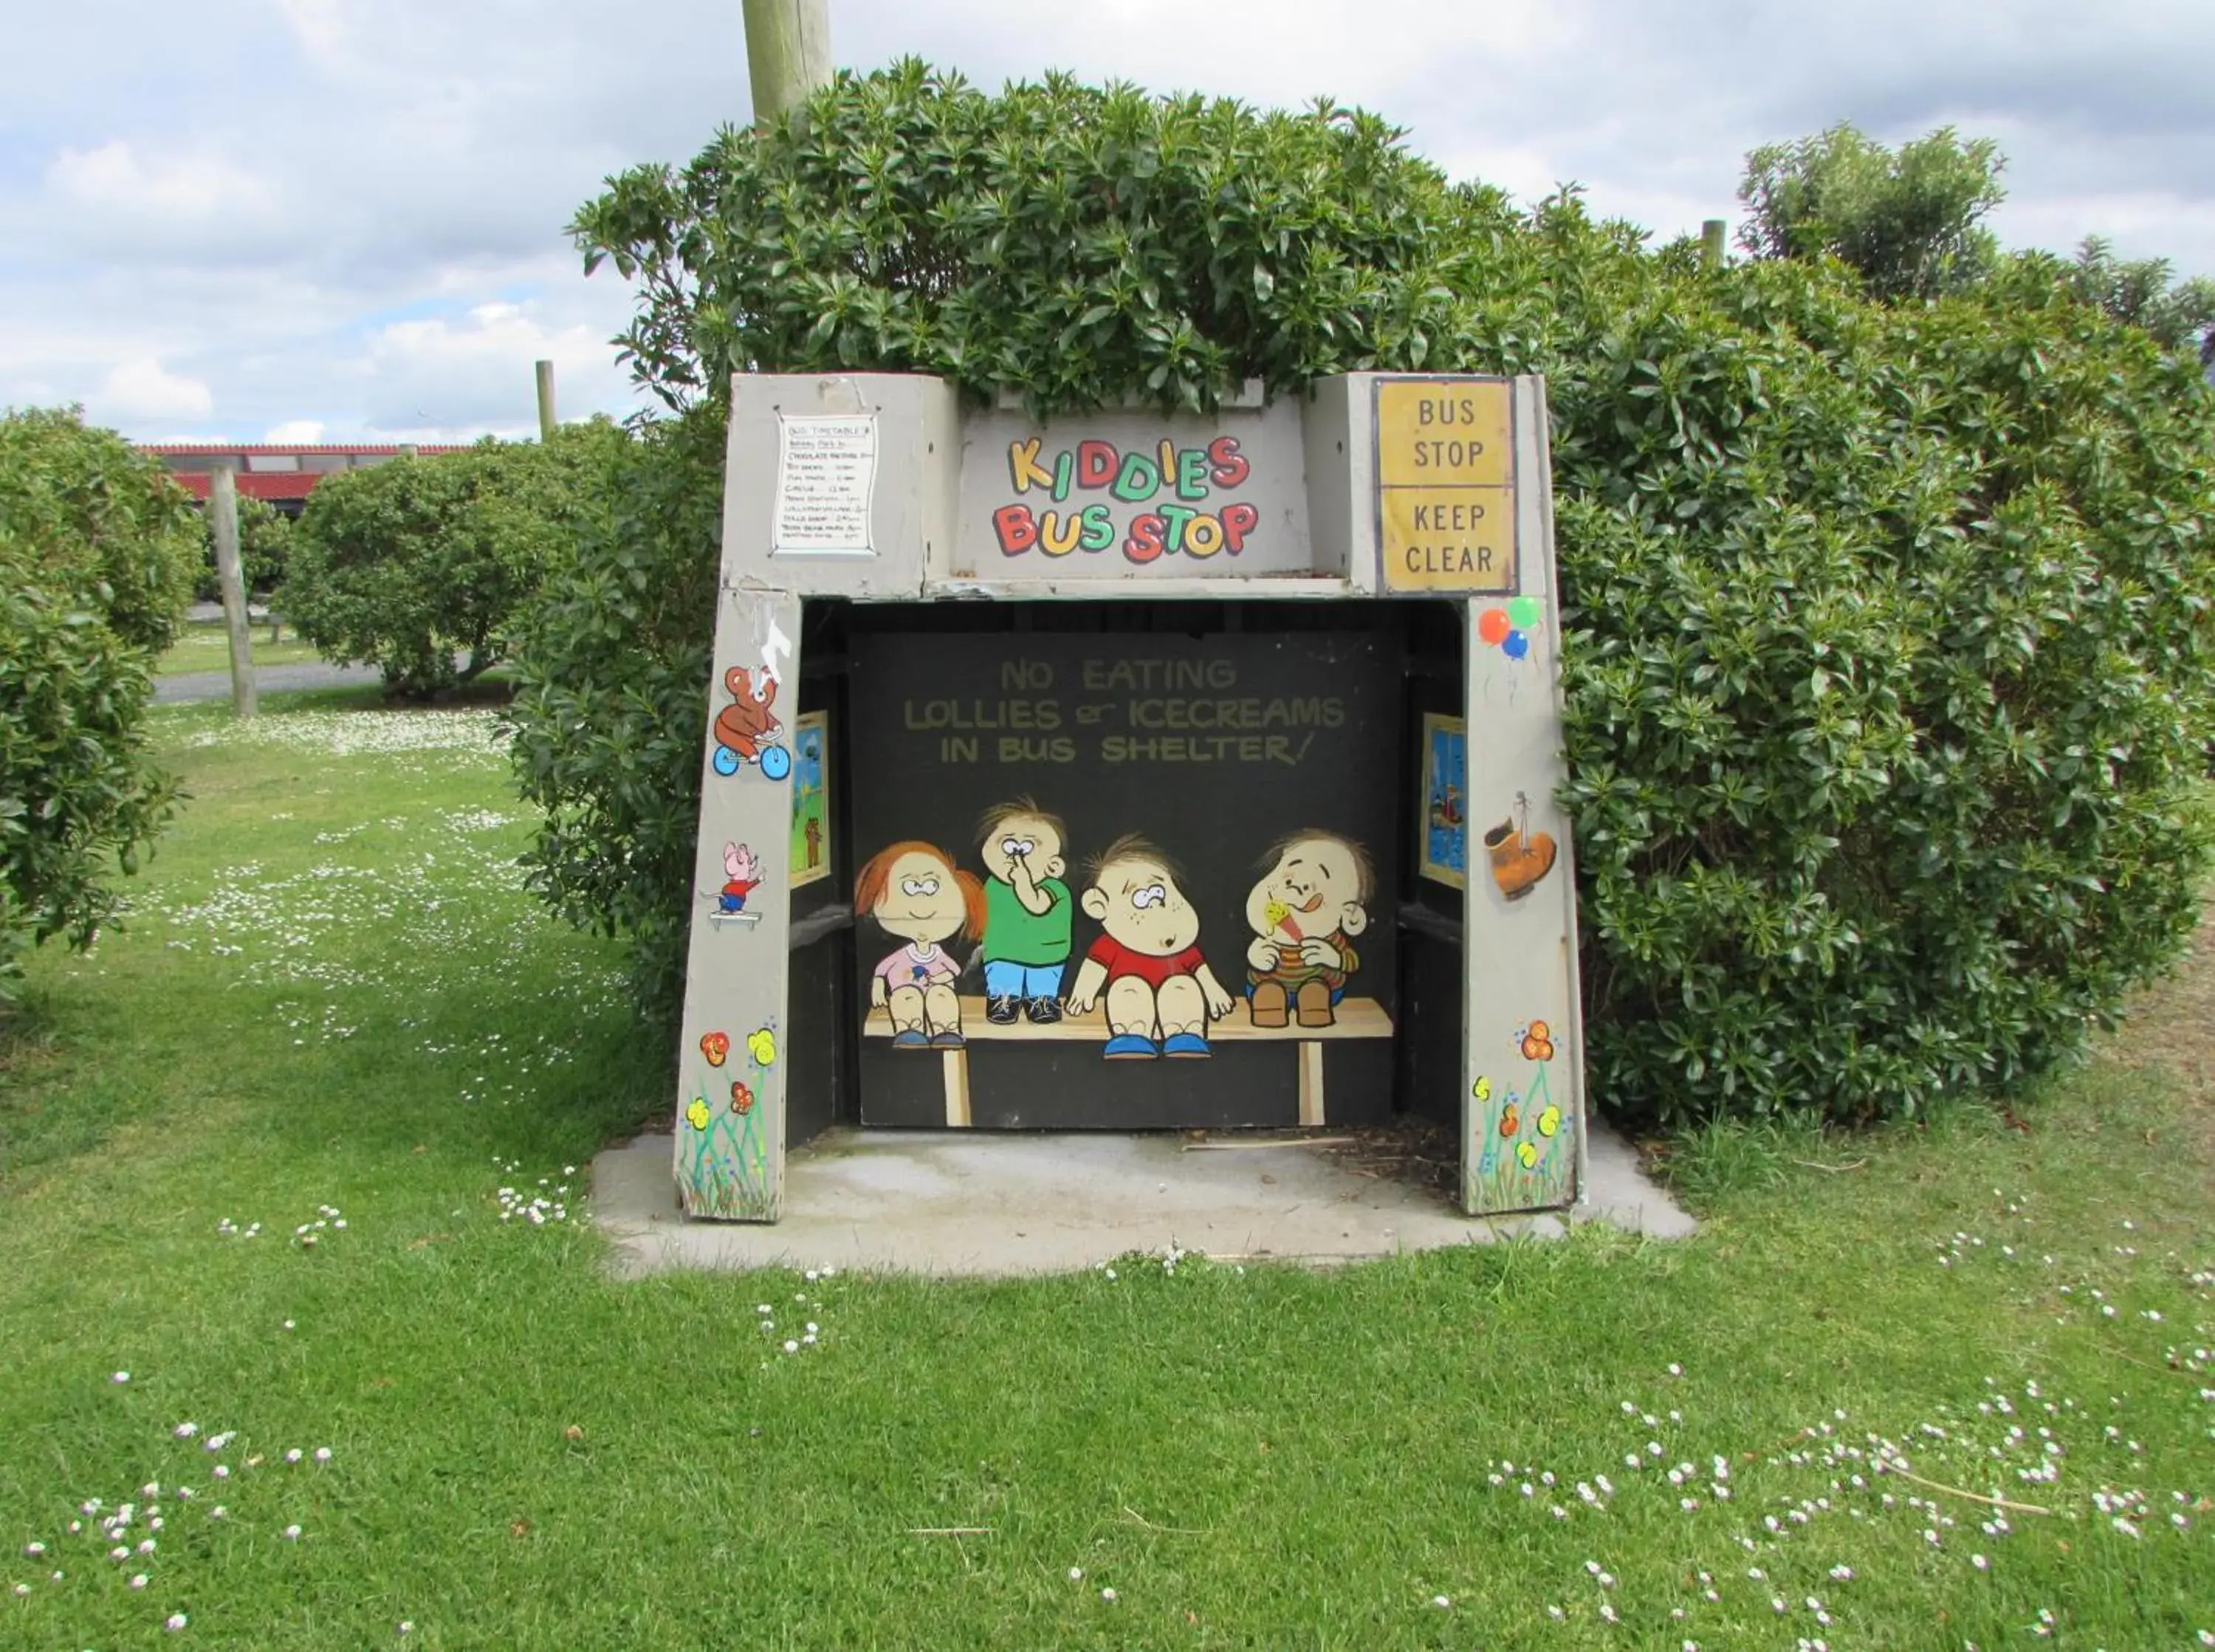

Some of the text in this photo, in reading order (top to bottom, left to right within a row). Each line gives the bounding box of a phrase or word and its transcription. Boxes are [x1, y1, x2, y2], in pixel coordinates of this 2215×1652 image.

[1419, 399, 1474, 425] BUS
[1414, 441, 1484, 467] STOP
[1007, 436, 1250, 503] KIDDIES
[1414, 505, 1485, 531] KEEP
[992, 502, 1259, 564] BUS STOP
[1405, 546, 1492, 573] CLEAR
[1001, 658, 1237, 691] NO EATING
[904, 699, 1062, 730] LOLLIES
[1129, 696, 1345, 729] ICECREAMS
[941, 737, 978, 763] IN
[998, 736, 1076, 763] BUS
